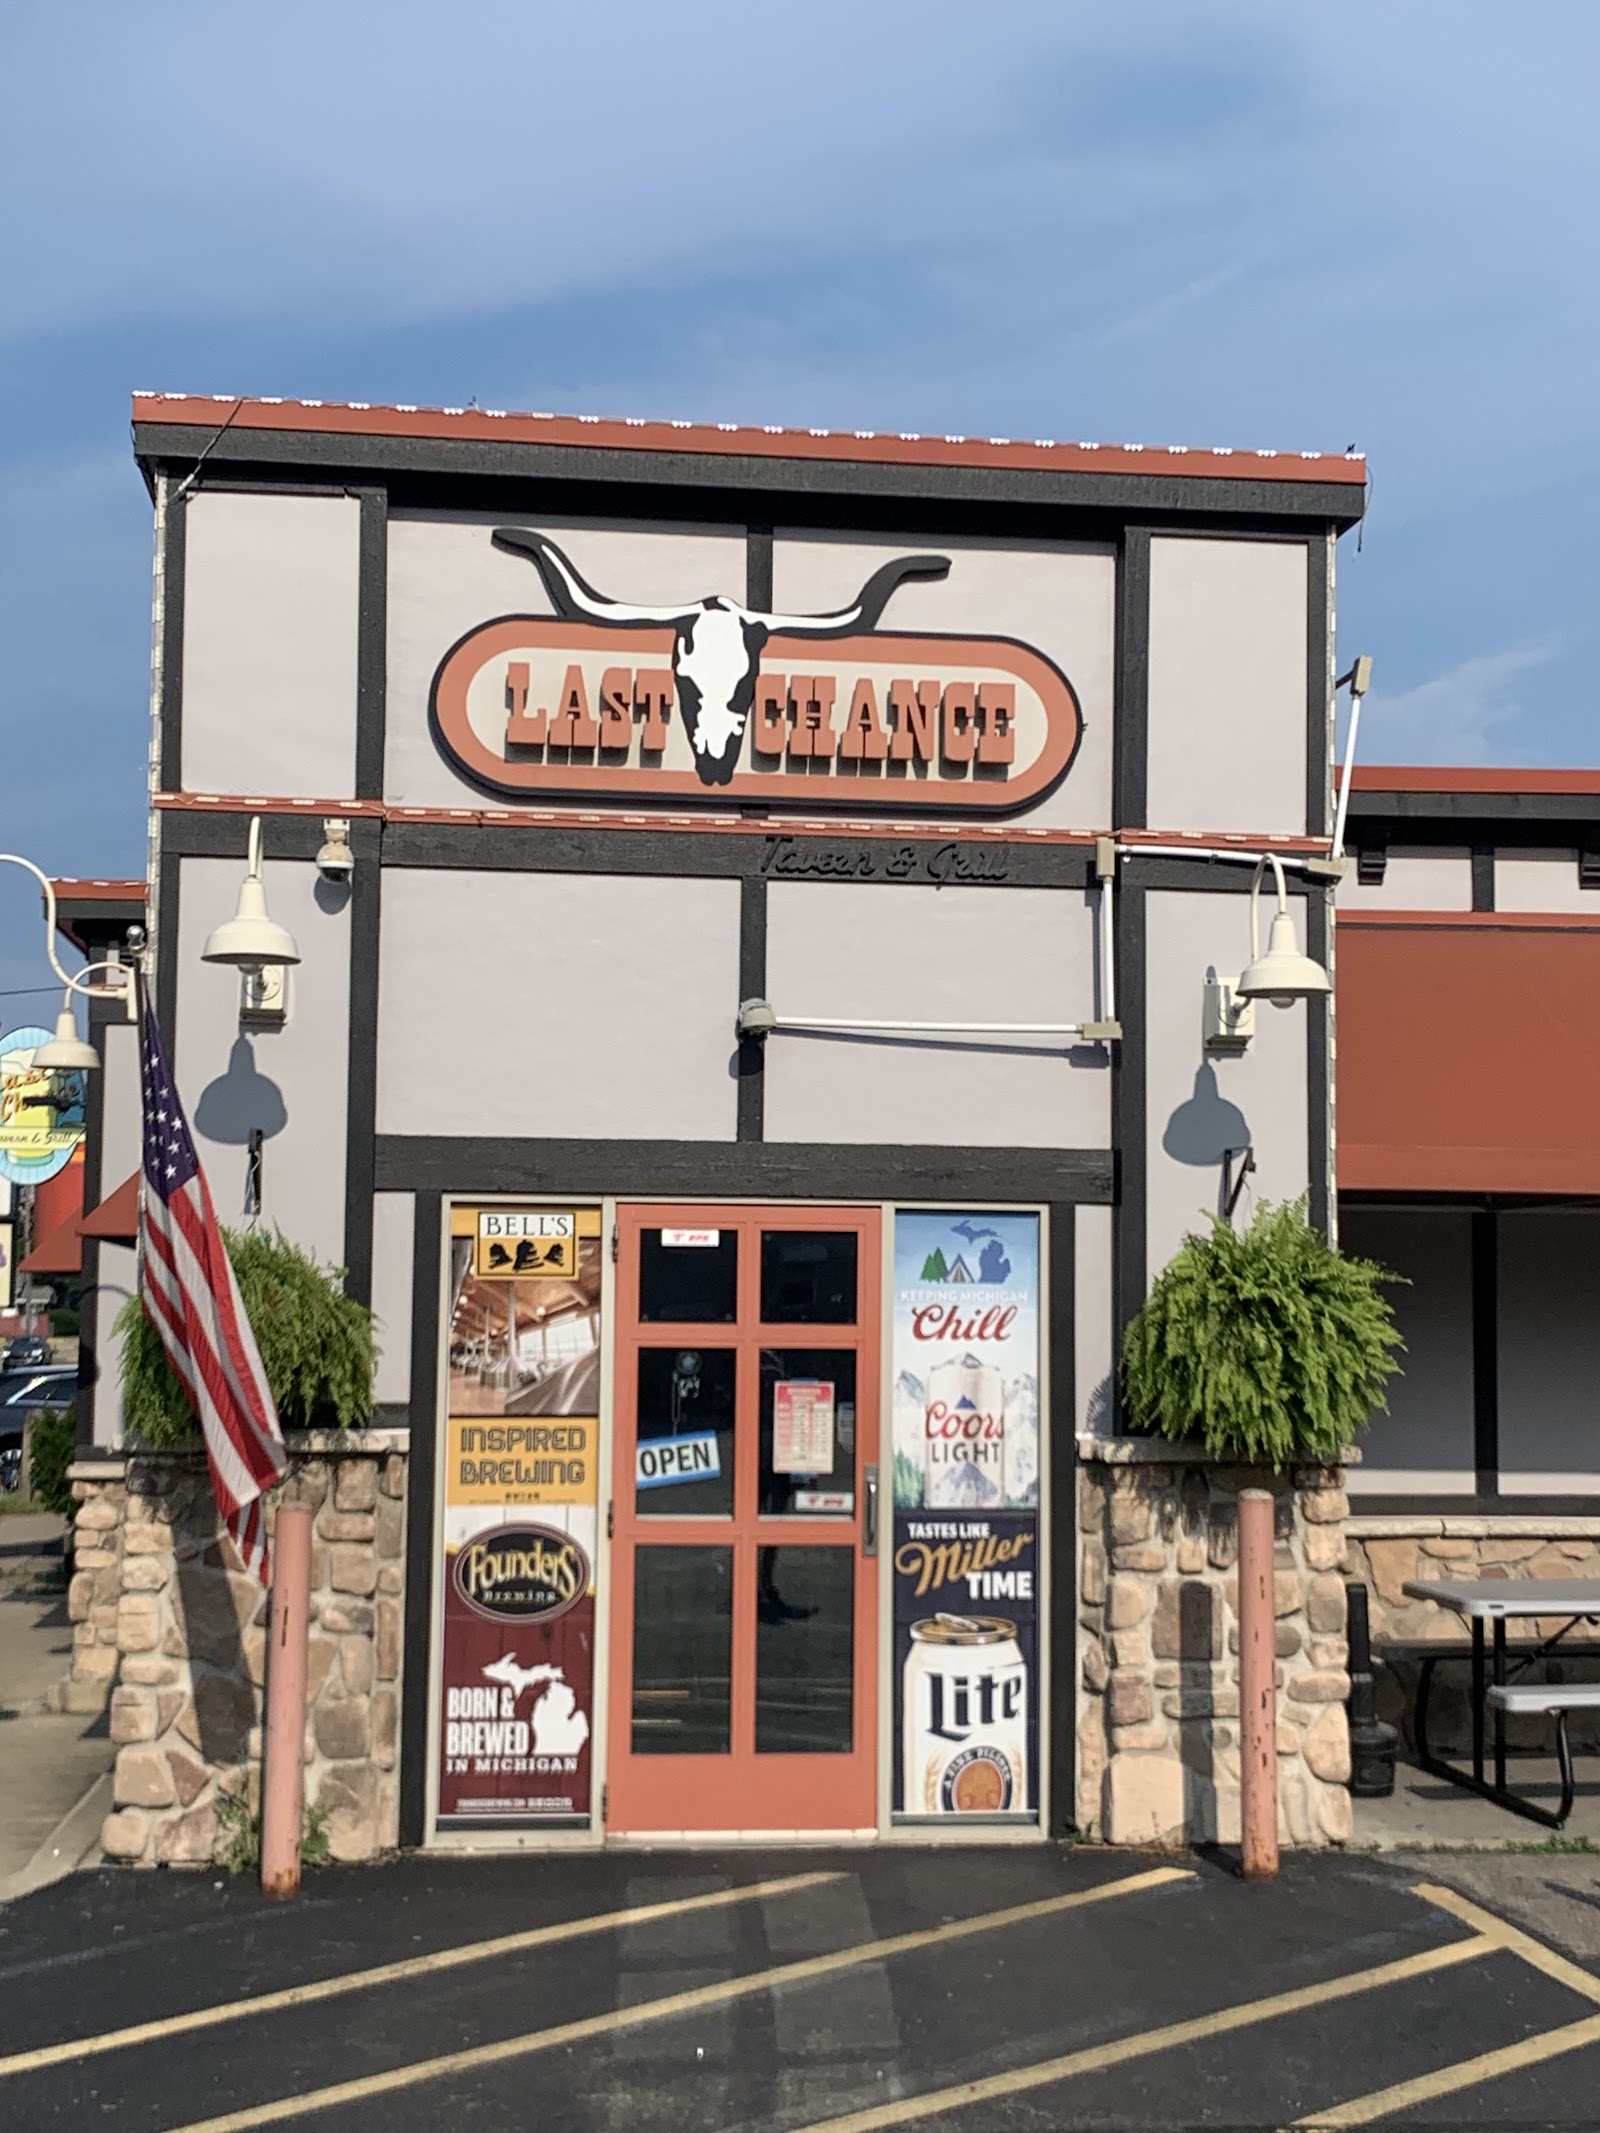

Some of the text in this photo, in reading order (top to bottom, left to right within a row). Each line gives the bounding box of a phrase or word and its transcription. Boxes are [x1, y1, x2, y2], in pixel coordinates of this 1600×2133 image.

[506, 661, 1015, 765] LAST CHANCE
[761, 835, 1011, 890] Tavern & Grill
[0, 1068, 49, 1092] ast
[487, 1216, 568, 1236] BELL'S
[902, 1290, 1028, 1302] KEEPING MICHIGAN
[911, 1304, 1017, 1341] Chill
[925, 1400, 1004, 1440] Coors
[461, 1426, 586, 1453] INSPIRED
[932, 1441, 999, 1463] LIGHT
[460, 1459, 585, 1485] BREWING
[640, 1443, 711, 1478] OPEN
[907, 1522, 991, 1540] TASTES LIKE
[469, 1538, 576, 1600] Founders
[895, 1533, 1034, 1597] Miller
[966, 1571, 1032, 1600] TIME
[447, 1686, 515, 1719] BORN &
[924, 1671, 1022, 1743] Lite
[446, 1720, 529, 1756] BREWED
[446, 1757, 578, 1774] IN MICHIGAN
